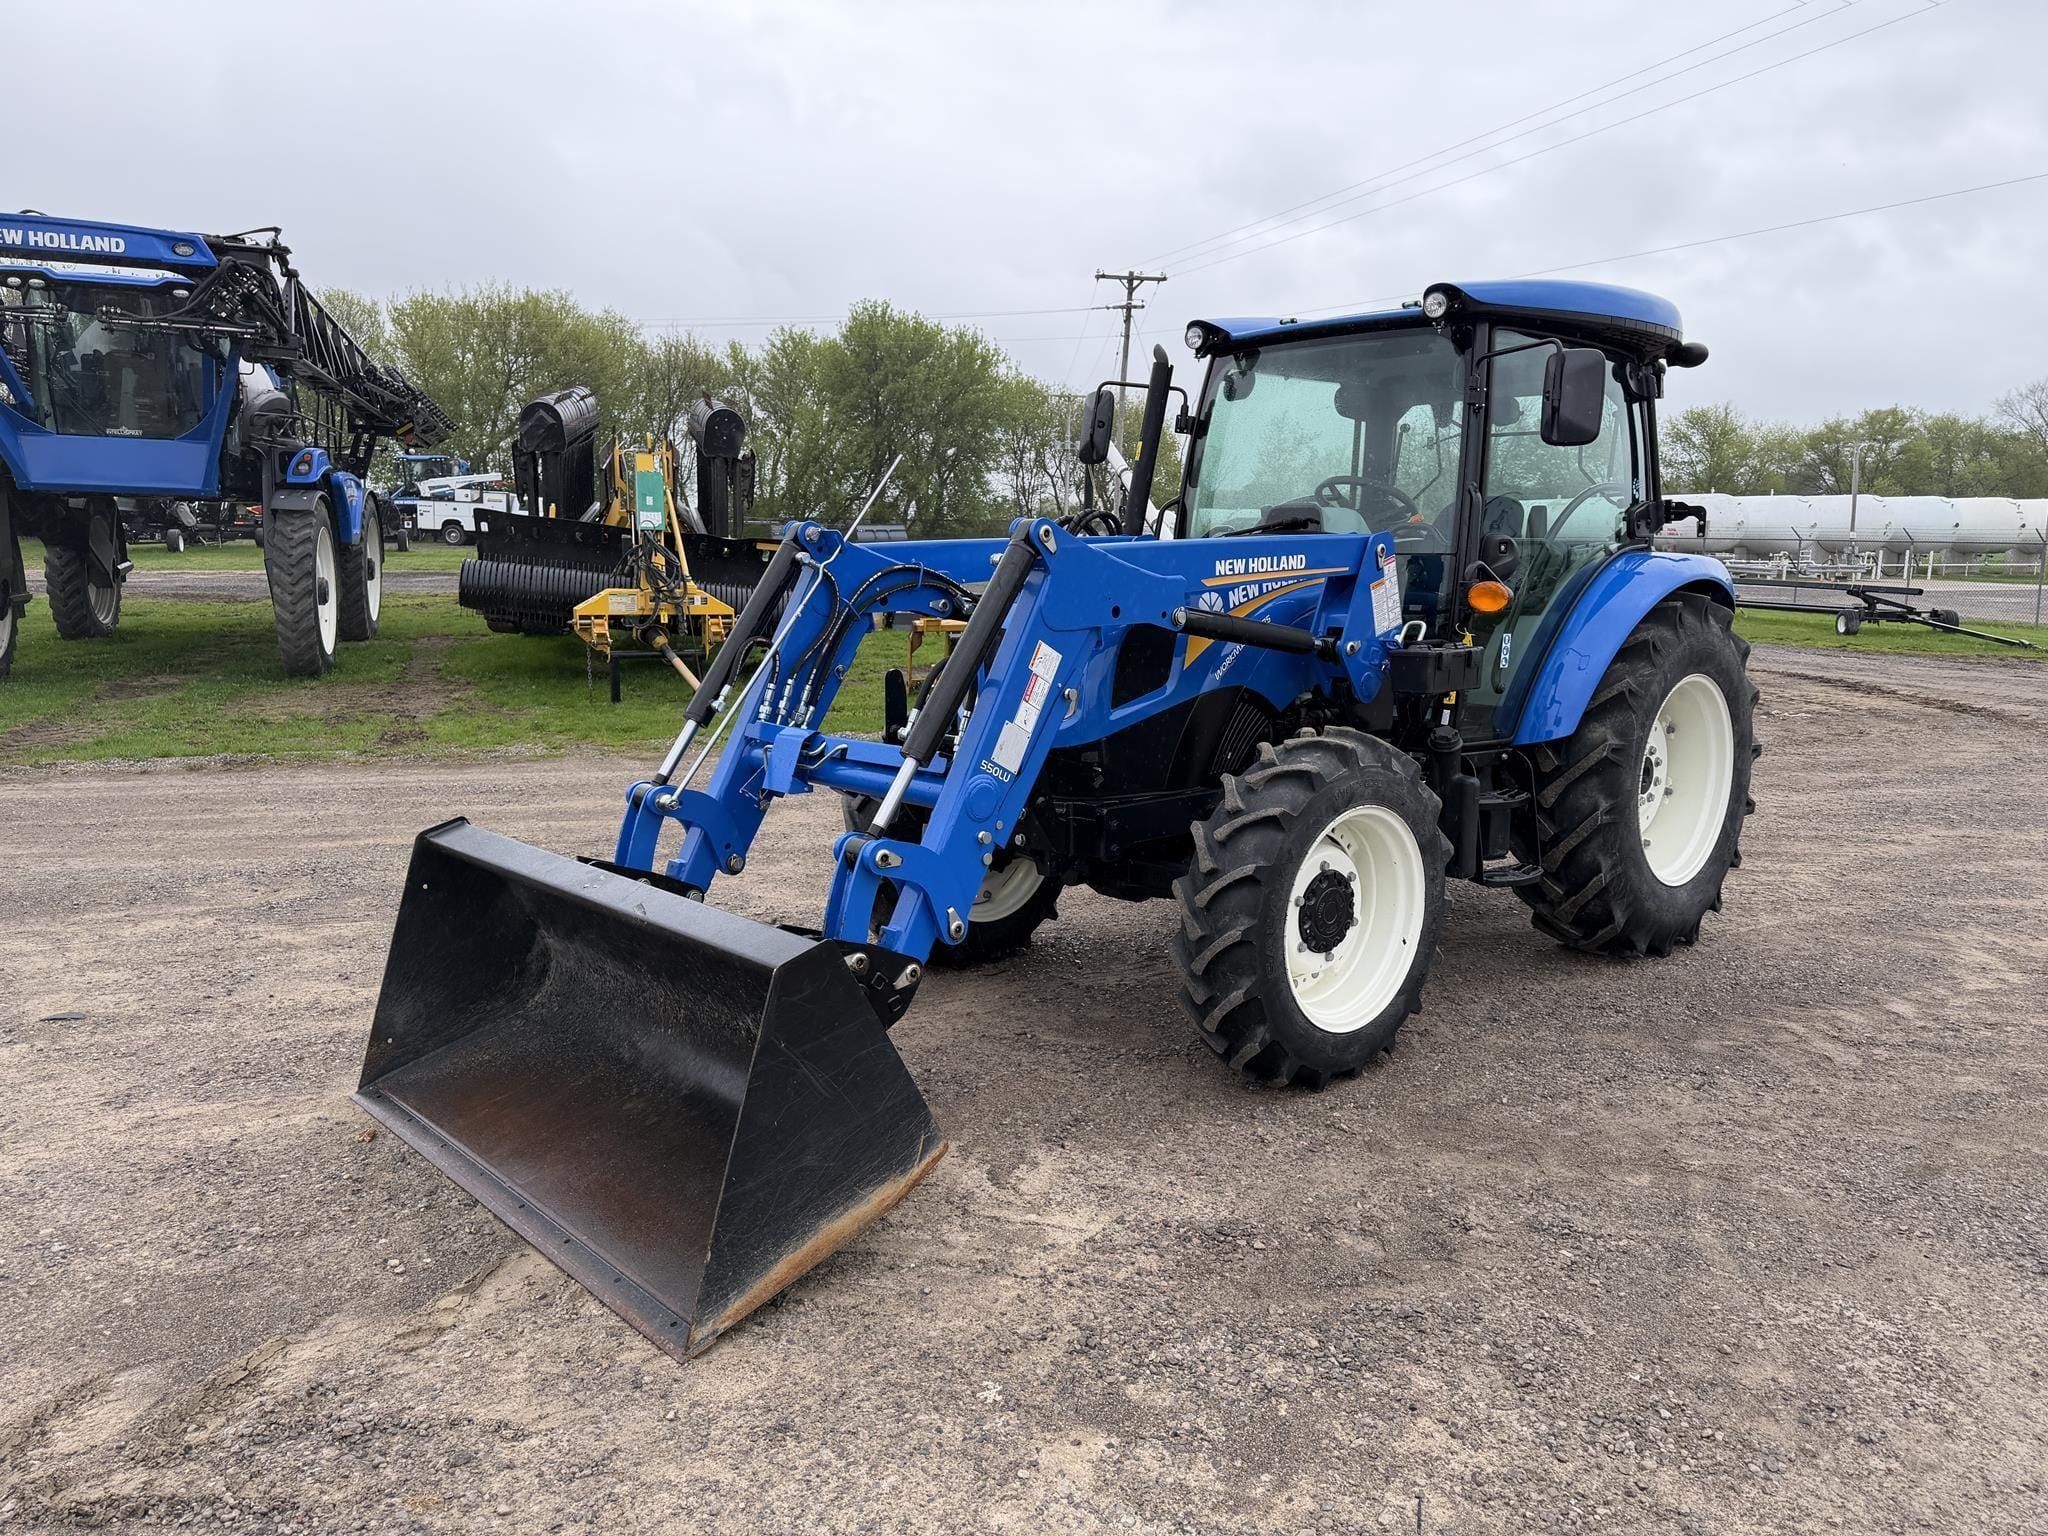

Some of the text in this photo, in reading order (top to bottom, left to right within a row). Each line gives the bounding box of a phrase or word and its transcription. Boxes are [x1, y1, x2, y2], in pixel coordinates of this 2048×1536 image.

[0, 228, 126, 253] W HOLLAND
[1215, 554, 1306, 576] NEW HOLLAND
[1228, 583, 1259, 609] NEW
[980, 759, 1011, 783] 550LU
